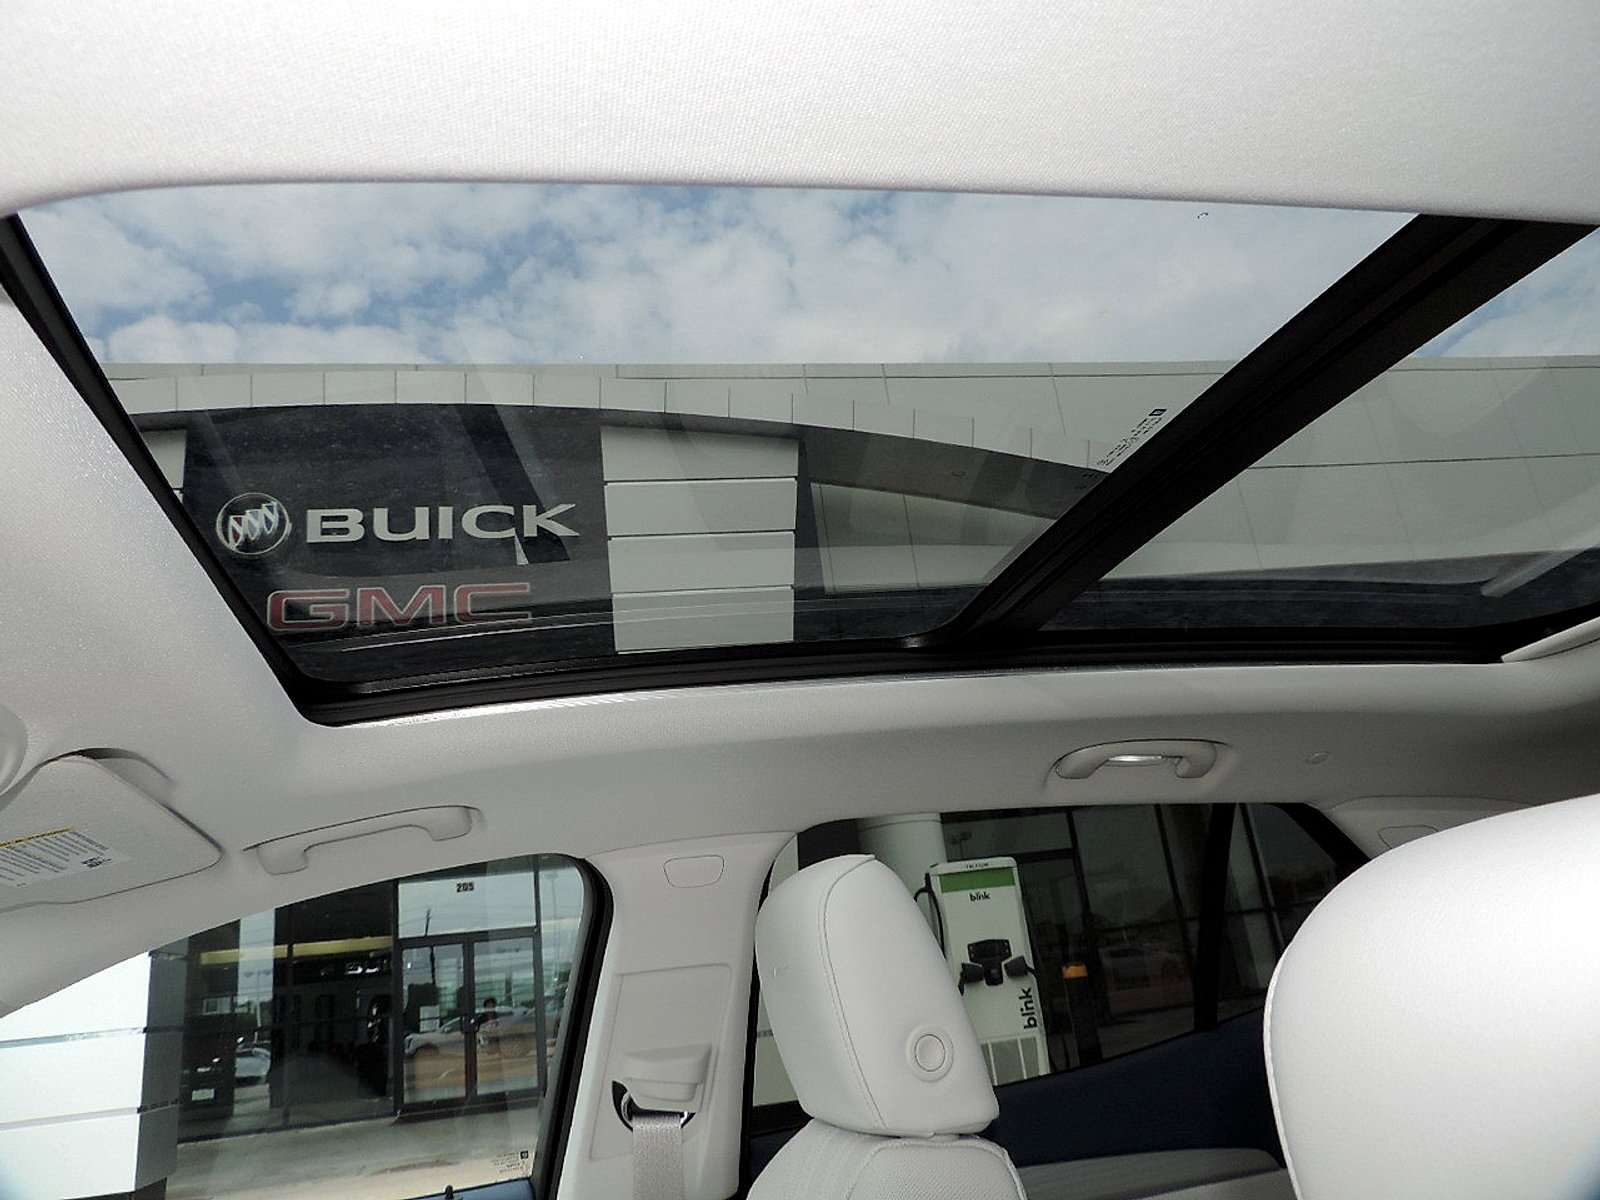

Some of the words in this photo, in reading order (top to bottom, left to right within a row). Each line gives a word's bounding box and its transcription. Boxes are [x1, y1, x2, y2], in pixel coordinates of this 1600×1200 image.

[307, 504, 580, 543] BUICK
[268, 582, 532, 632] GMC
[969, 891, 991, 902] blink
[1019, 987, 1038, 1029] blink
